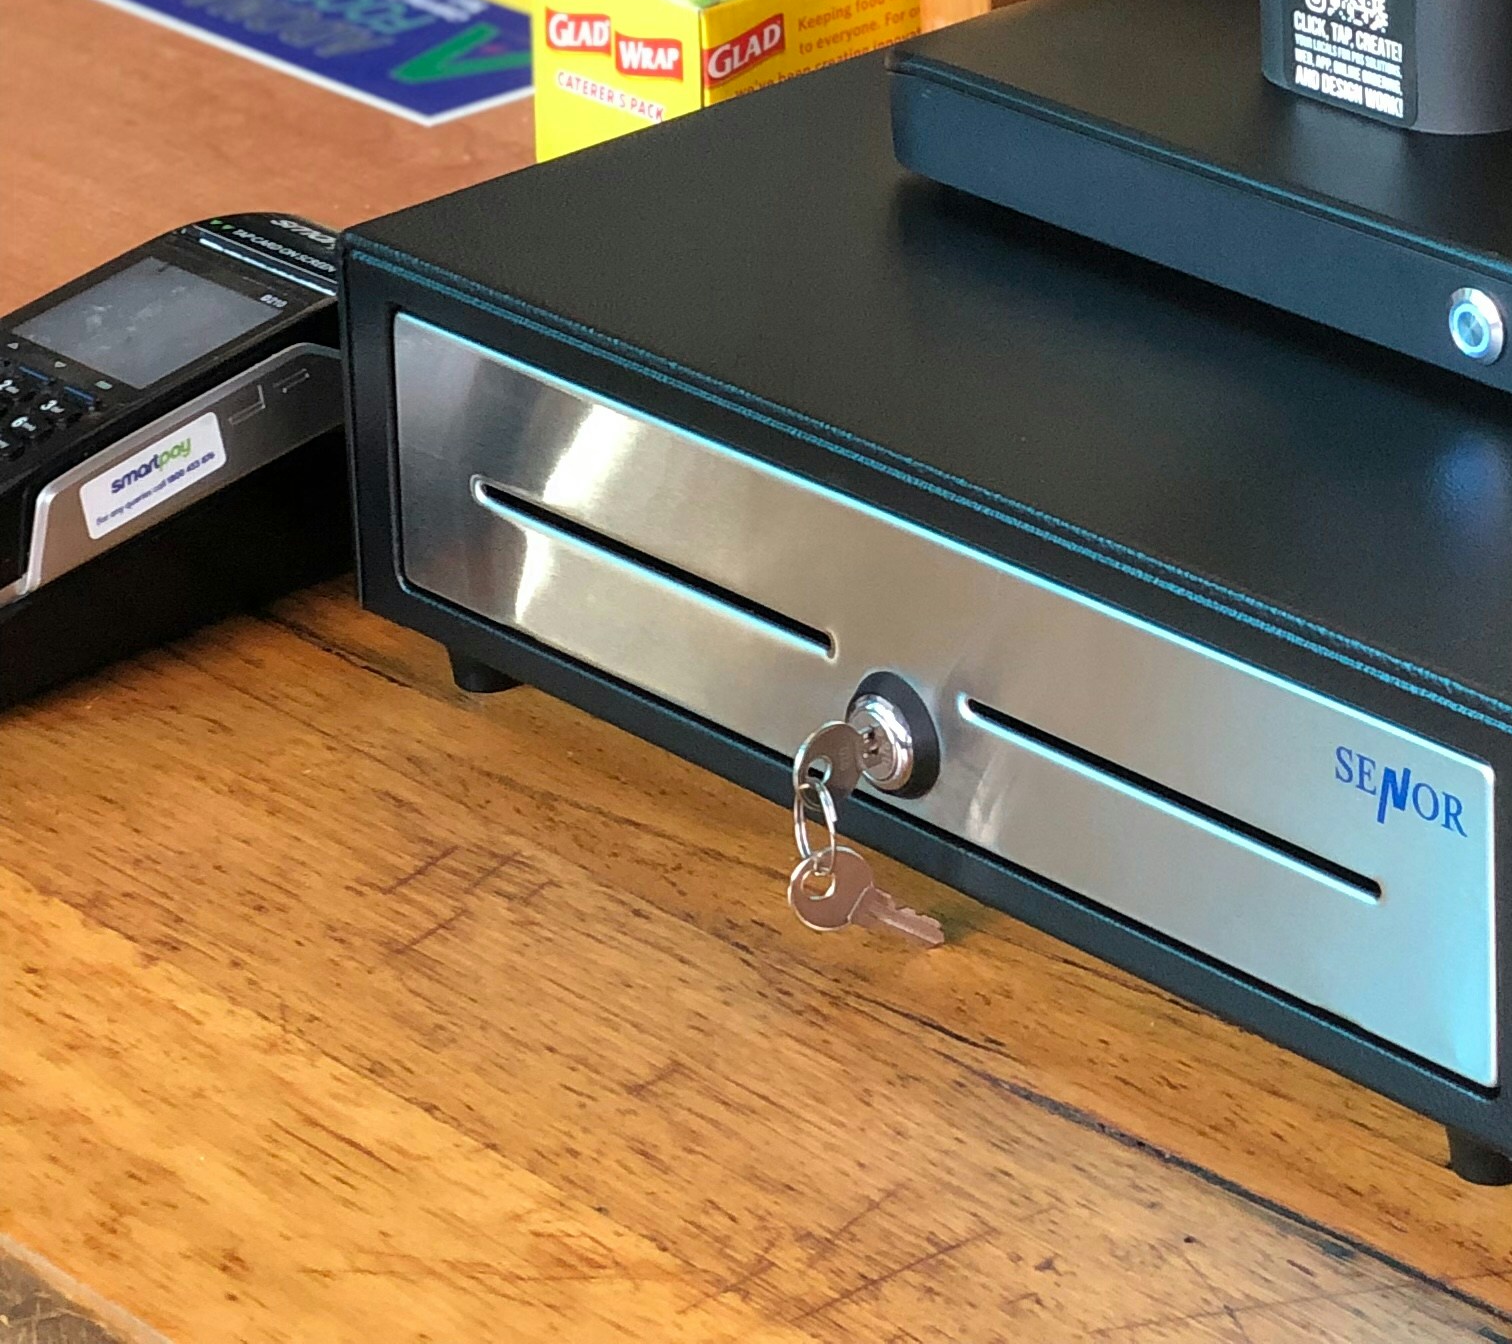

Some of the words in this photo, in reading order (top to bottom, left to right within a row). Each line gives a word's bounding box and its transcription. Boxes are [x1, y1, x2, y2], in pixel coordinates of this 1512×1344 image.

[547, 13, 610, 48] GLAD
[798, 4, 853, 32] Keeping
[799, 41, 813, 55] to
[816, 21, 881, 50] everyone.
[884, 11, 905, 26] For
[707, 23, 782, 79] GLAD
[1294, 10, 1329, 41] CLICK,
[1355, 30, 1403, 63] CREATE!
[619, 39, 680, 71] WRAP
[814, 45, 870, 69] creating
[1295, 64, 1320, 91] AND
[1321, 72, 1363, 105] DESIGN
[629, 96, 665, 123] PACK
[250, 237, 283, 250] CARD
[295, 252, 337, 273] SCREEN
[11, 416, 29, 428] 6
[40, 399, 58, 411] 3
[111, 438, 192, 493] smartpay
[1335, 745, 1468, 838] SENOR
